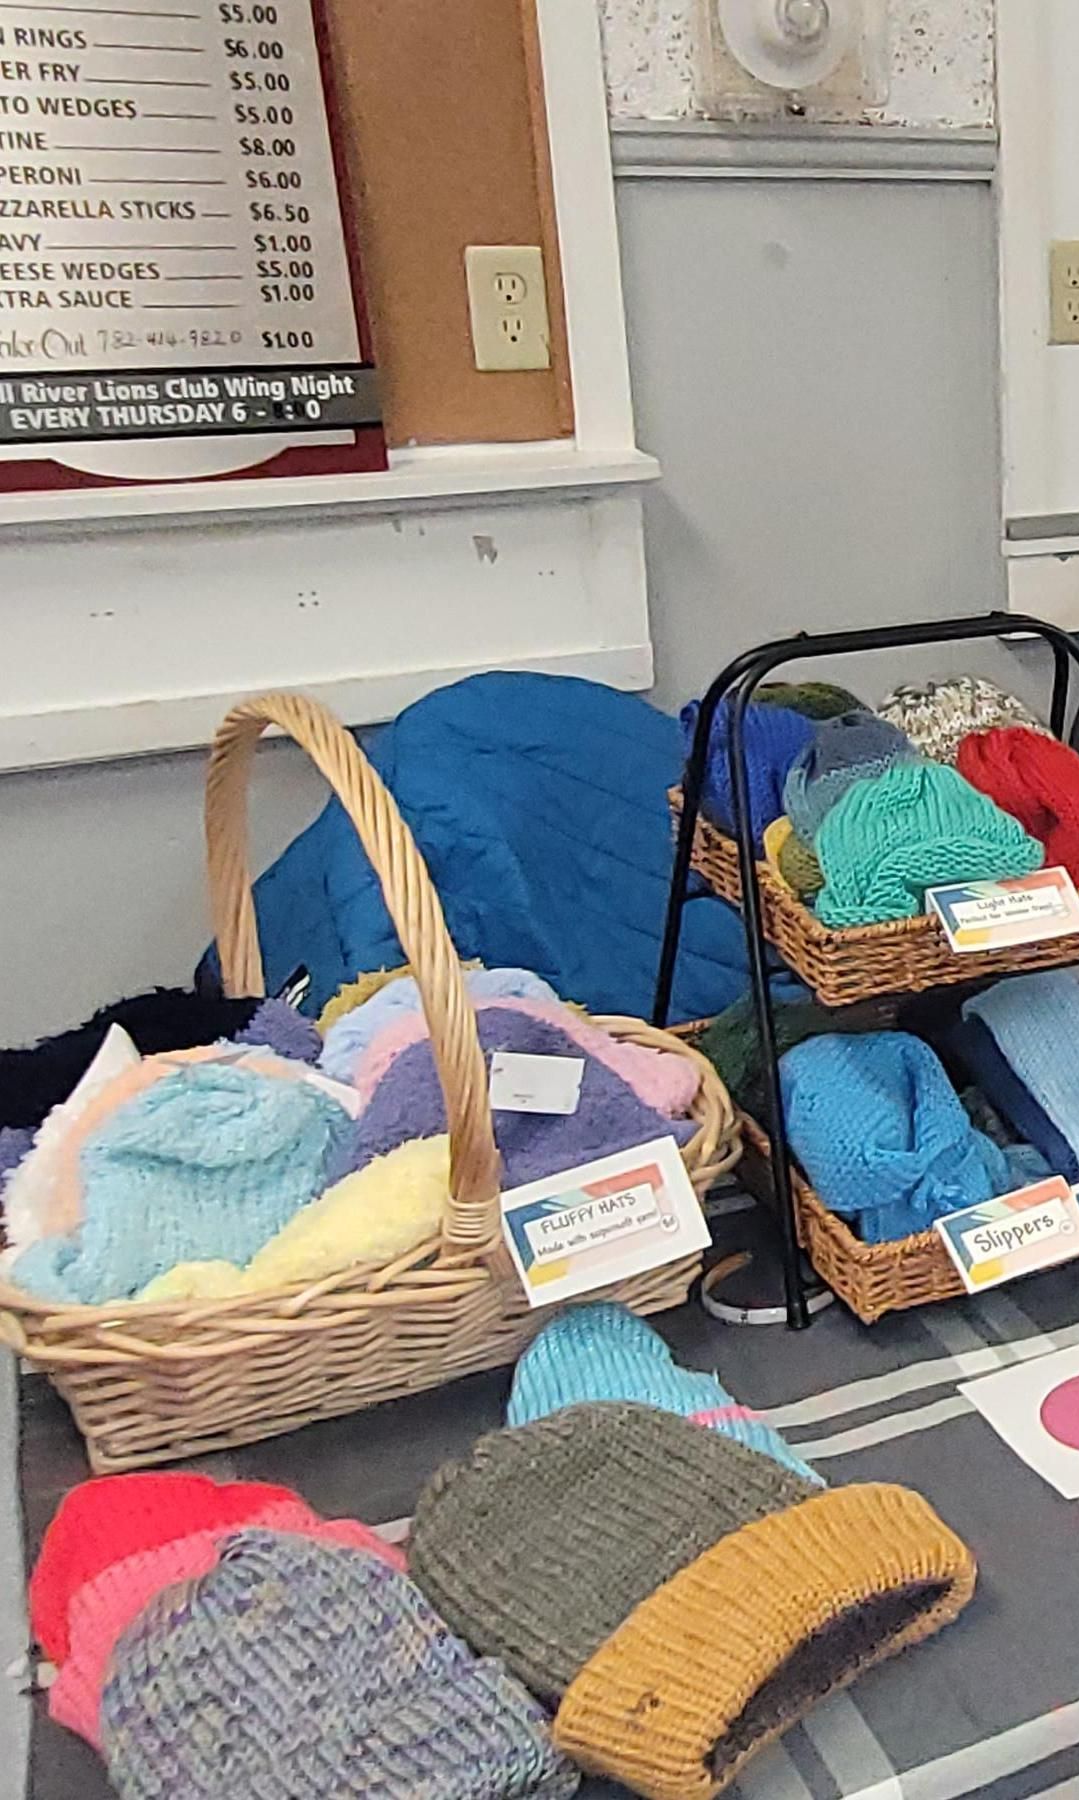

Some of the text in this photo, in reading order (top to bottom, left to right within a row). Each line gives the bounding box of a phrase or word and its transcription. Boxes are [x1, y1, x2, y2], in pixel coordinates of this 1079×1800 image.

[220, 3, 278, 24] $5.00
[15, 27, 87, 49] RINGS
[225, 38, 284, 60] $6.00
[39, 62, 81, 83] FRY
[229, 71, 290, 92] $5.00
[37, 97, 138, 120] WEDGES
[234, 104, 294, 125] $5.00
[239, 138, 296, 157] $8.00
[246, 170, 302, 190] $6.00
[121, 201, 197, 220] STICKS
[249, 202, 310, 224] $6.50
[254, 234, 312, 253] $1.00
[63, 263, 160, 280] WEDGES
[256, 260, 314, 279] $5.00
[0, 284, 314, 309] TRA SAUCE $1.00
[22, 381, 87, 404] River
[94, 380, 158, 402] Lions
[165, 377, 219, 399] Club
[223, 375, 286, 401] Wing
[290, 373, 355, 400] Night
[10, 407, 90, 430] EVERY
[97, 402, 225, 427] THURSDAY
[232, 402, 247, 422] 6
[541, 1192, 636, 1234] FLUFFY HATS
[973, 1213, 1055, 1253] Slippers
